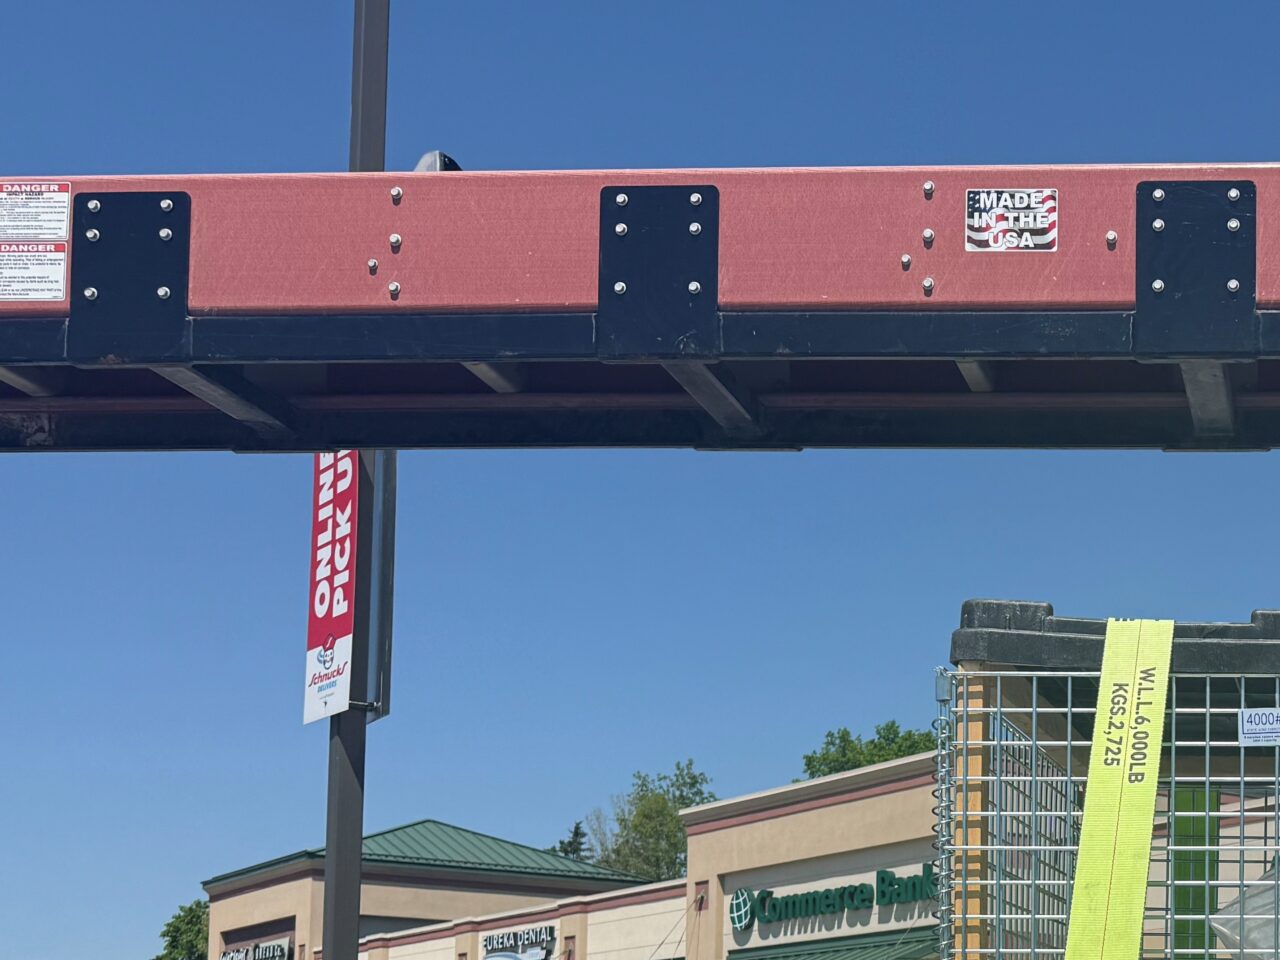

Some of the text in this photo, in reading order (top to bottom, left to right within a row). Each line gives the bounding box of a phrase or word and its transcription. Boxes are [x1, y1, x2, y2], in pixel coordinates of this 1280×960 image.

[2, 184, 59, 192] DANGER
[979, 192, 1043, 209] MADE
[973, 212, 1050, 228] IN THE
[1, 244, 55, 252] DANGER
[988, 232, 1035, 248] USA
[314, 452, 334, 618] ONLINE
[332, 499, 352, 618] PICK
[308, 660, 349, 688] Schnucks
[756, 863, 940, 924] Commerce Bank
[483, 926, 551, 951] EUREKA DENTAL
